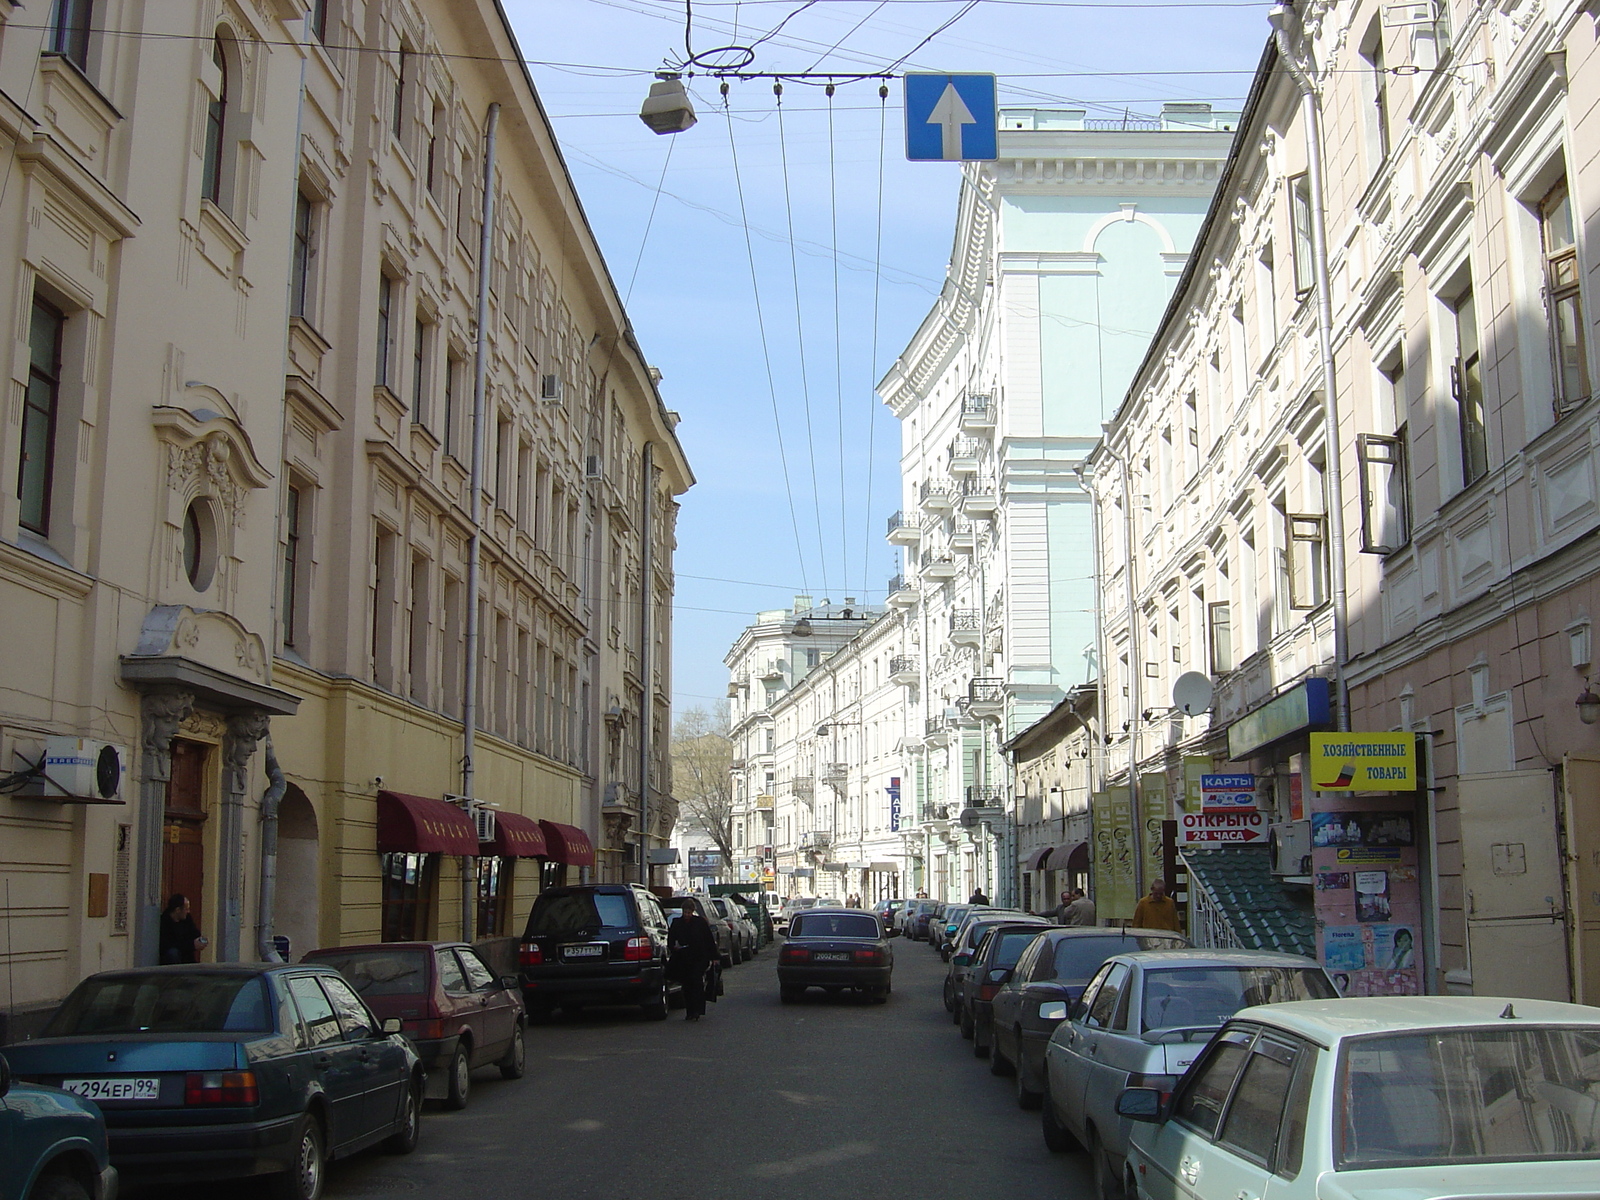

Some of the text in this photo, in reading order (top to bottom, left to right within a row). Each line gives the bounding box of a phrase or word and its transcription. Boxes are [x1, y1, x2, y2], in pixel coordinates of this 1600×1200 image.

[1322, 742, 1406, 757] ХОЗЯЙСТВЕННЫЕ
[1367, 767, 1407, 779] ТОВАРЫ
[1205, 778, 1252, 786] КАРТЫ
[1183, 813, 1262, 827] ОТКРЫТО
[423, 819, 470, 839] REPLAY
[1193, 831, 1244, 840] 24 ЧАСА
[137, 1080, 153, 1093] 99
